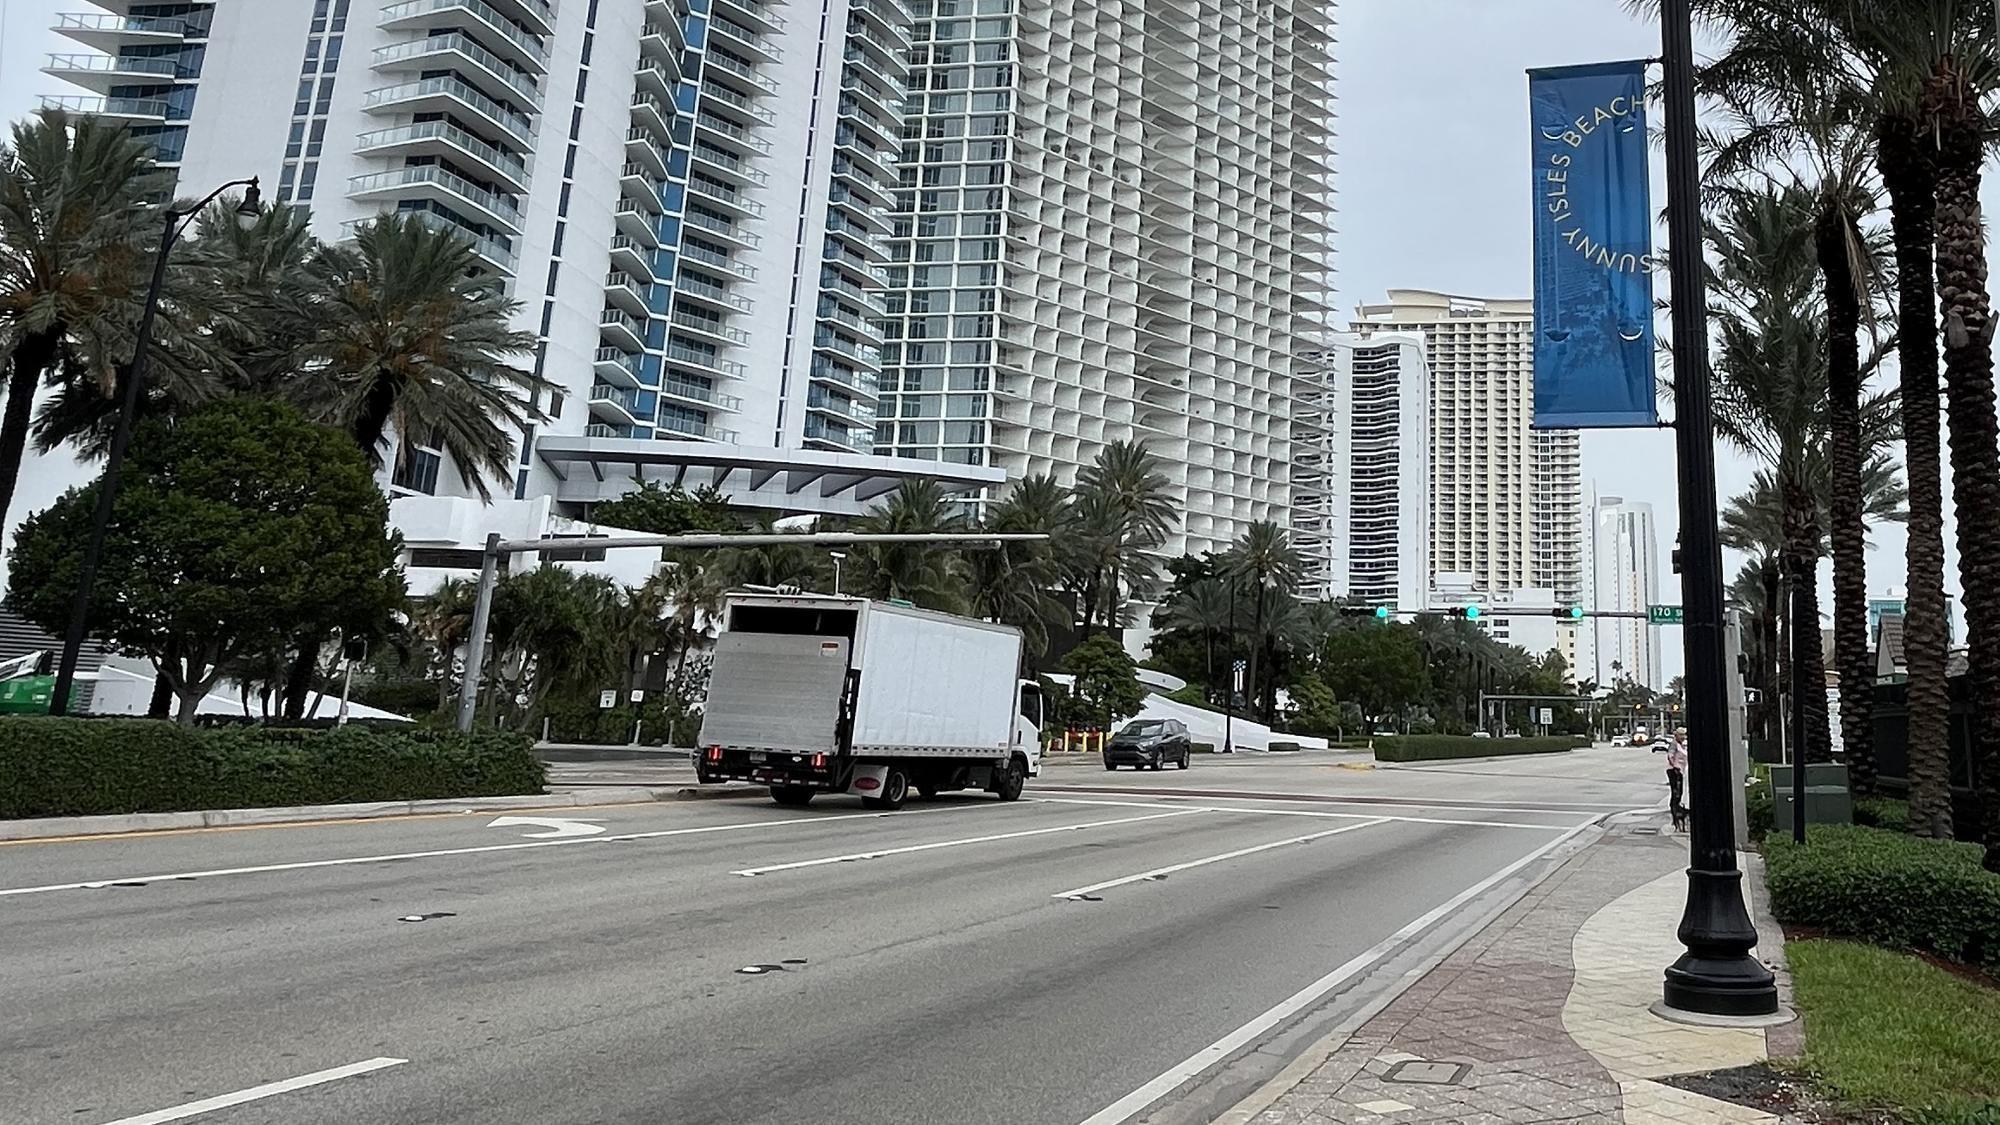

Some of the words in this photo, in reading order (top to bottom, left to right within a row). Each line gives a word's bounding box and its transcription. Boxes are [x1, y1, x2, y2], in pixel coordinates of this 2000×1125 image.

[1562, 95, 1647, 148] BEACH
[1547, 153, 1572, 222] ISLES
[1561, 227, 1652, 273] SUNNY
[1653, 607, 1671, 617] 170
